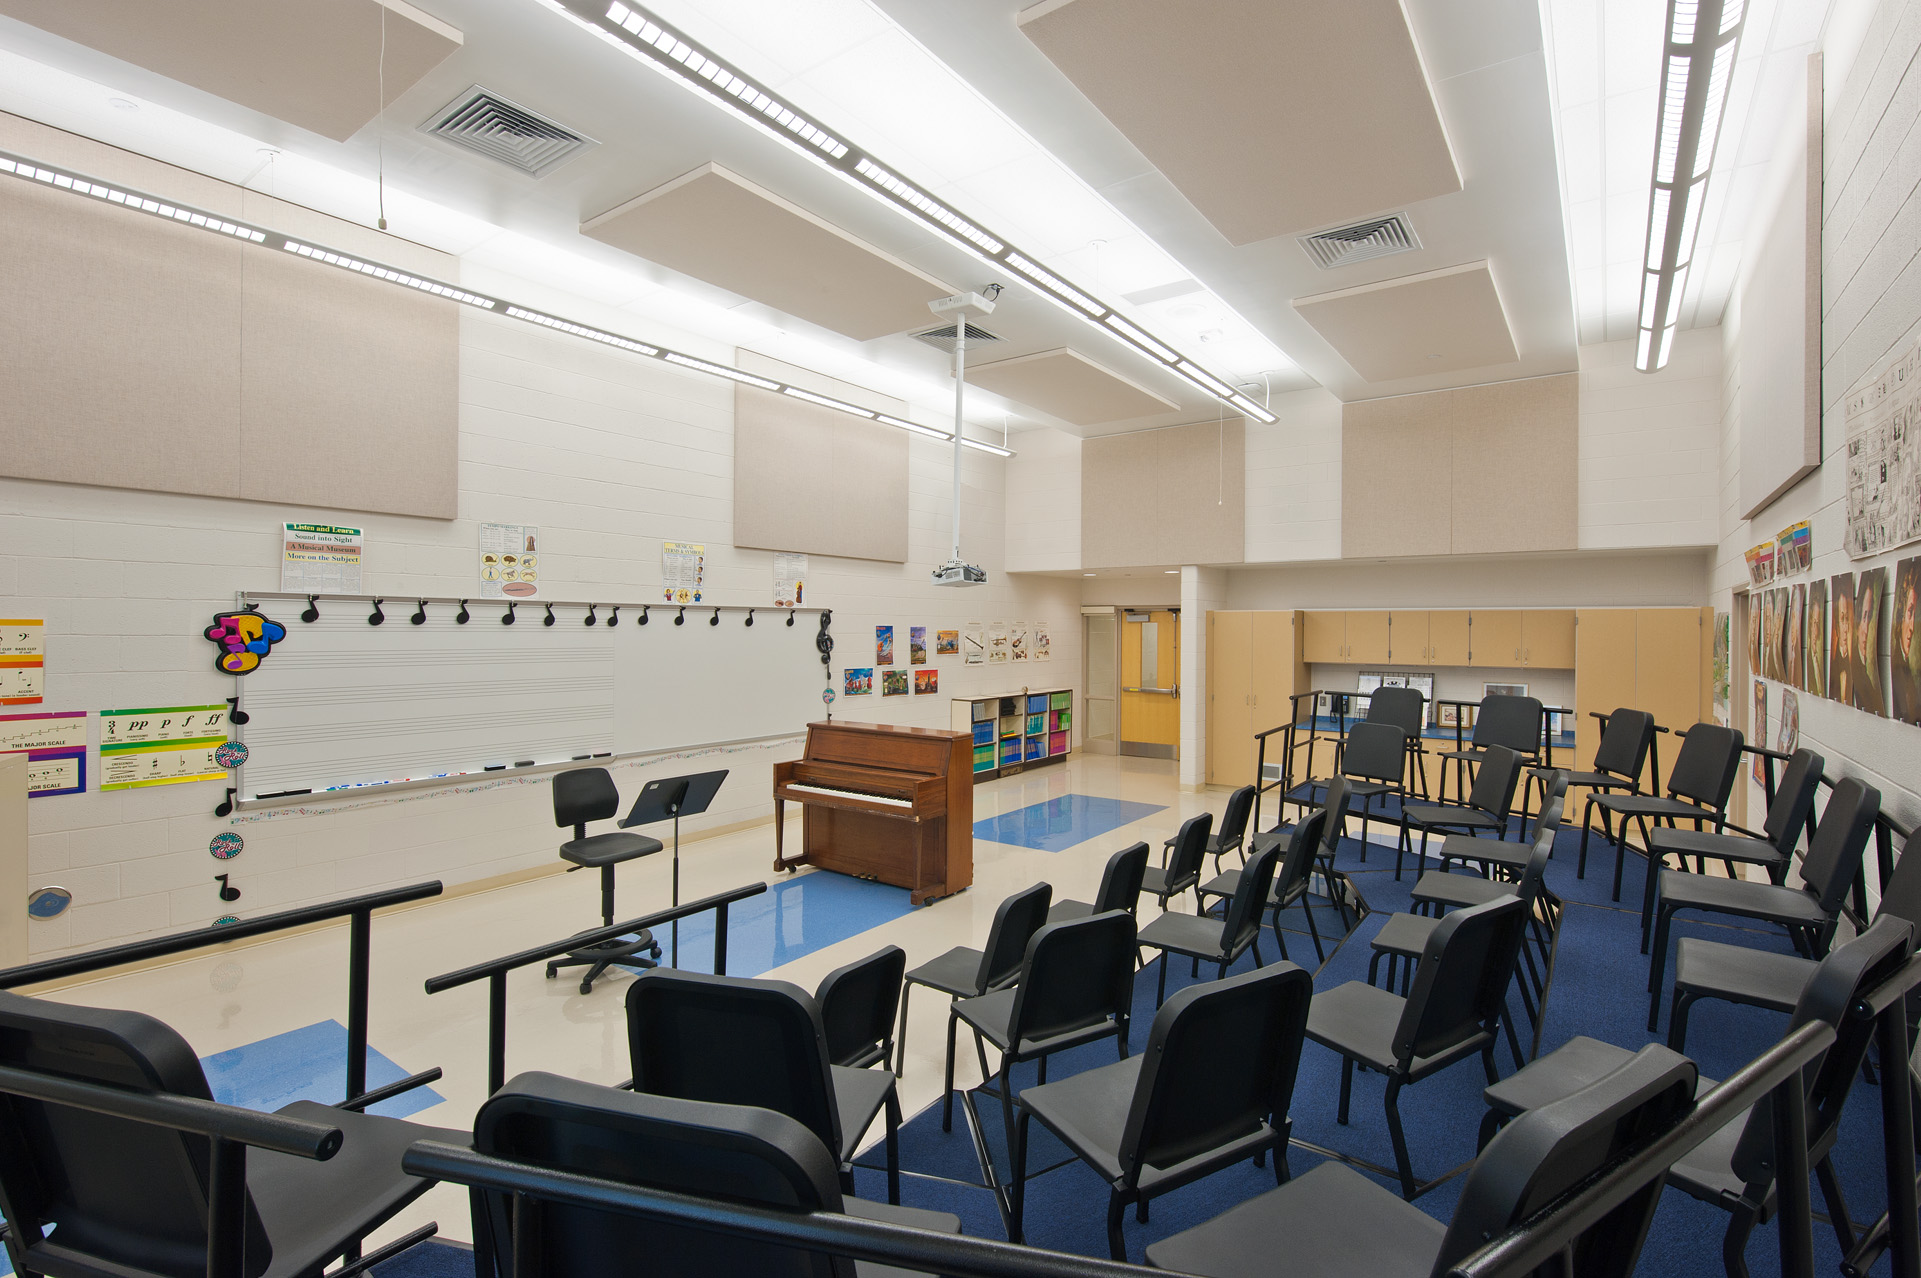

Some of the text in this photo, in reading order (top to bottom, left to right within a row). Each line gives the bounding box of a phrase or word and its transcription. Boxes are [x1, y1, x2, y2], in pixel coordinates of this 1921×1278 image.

[293, 523, 315, 531] Listen
[332, 526, 354, 534] Learn
[295, 533, 316, 541] Sound
[333, 536, 353, 544] Sight
[297, 543, 325, 551] Musical
[326, 545, 356, 553] Museum
[331, 555, 359, 563] Subject
[223, 752, 246, 761] Roll
[219, 842, 241, 852] Roll
